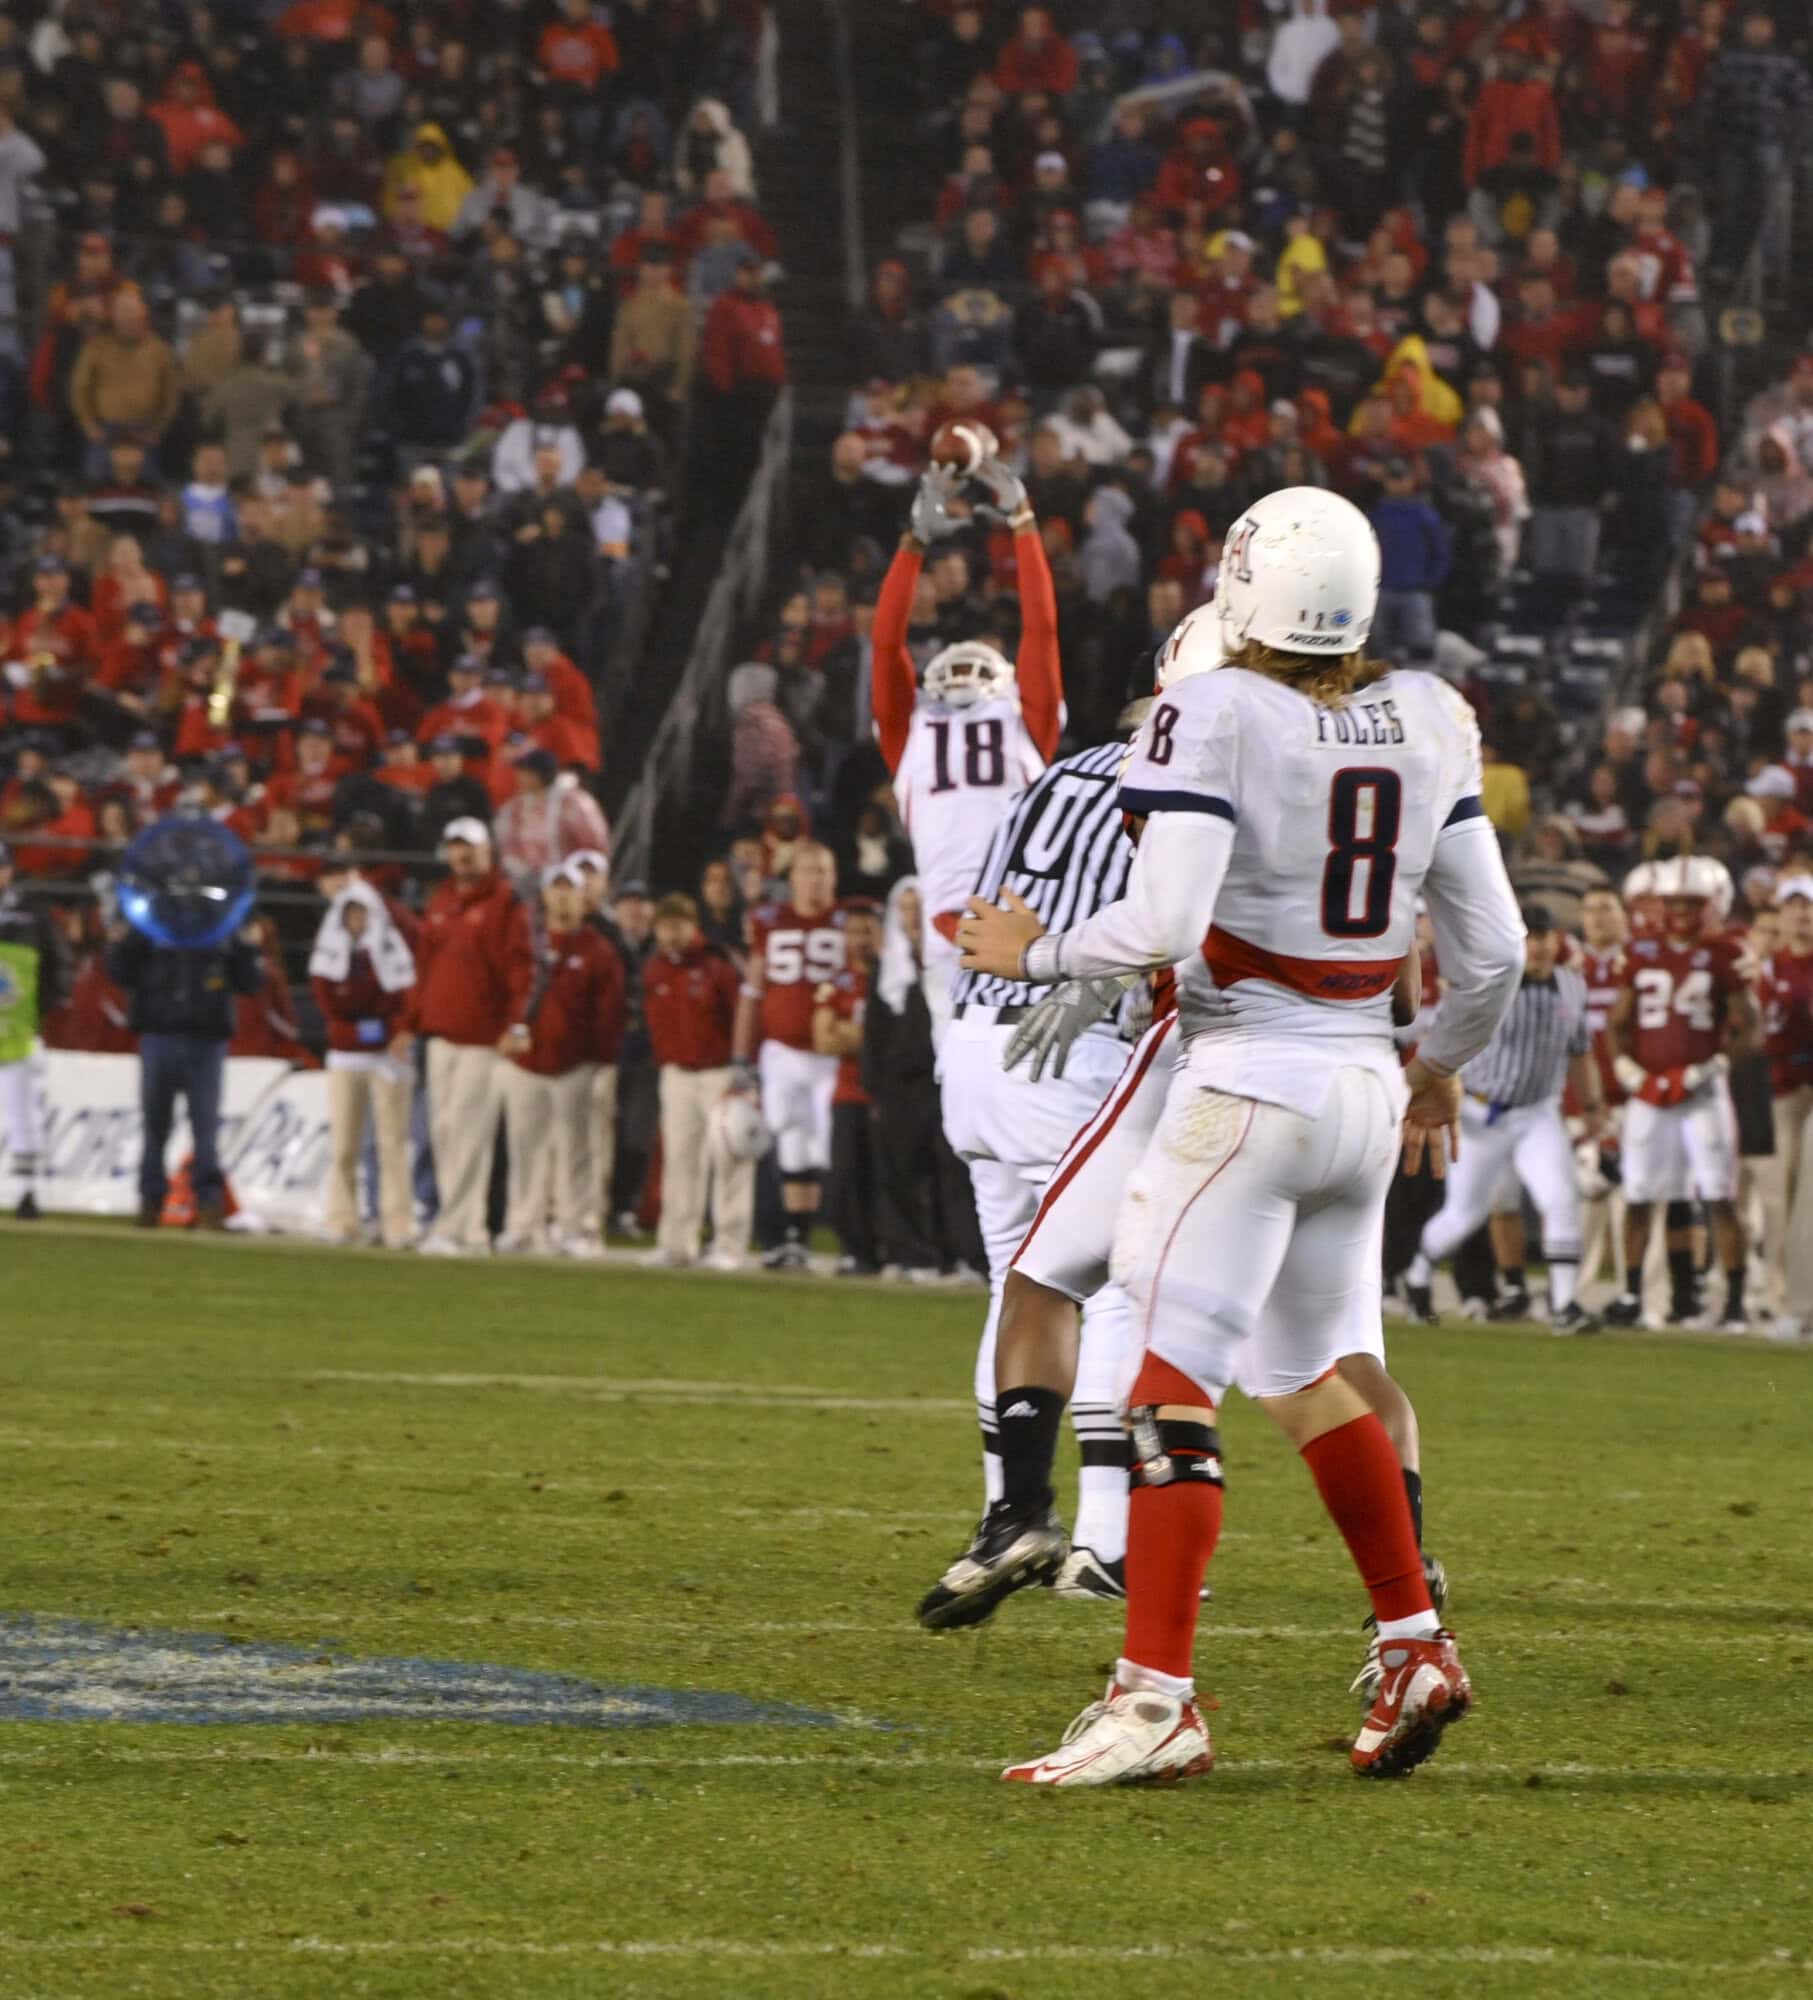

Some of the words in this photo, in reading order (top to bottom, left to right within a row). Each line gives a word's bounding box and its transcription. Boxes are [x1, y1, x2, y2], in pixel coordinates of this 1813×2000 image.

[926, 719, 1005, 794] 18
[1148, 703, 1180, 766] 8
[1023, 774, 1106, 873] U
[1321, 767, 1402, 938] 8
[766, 929, 846, 984] 59
